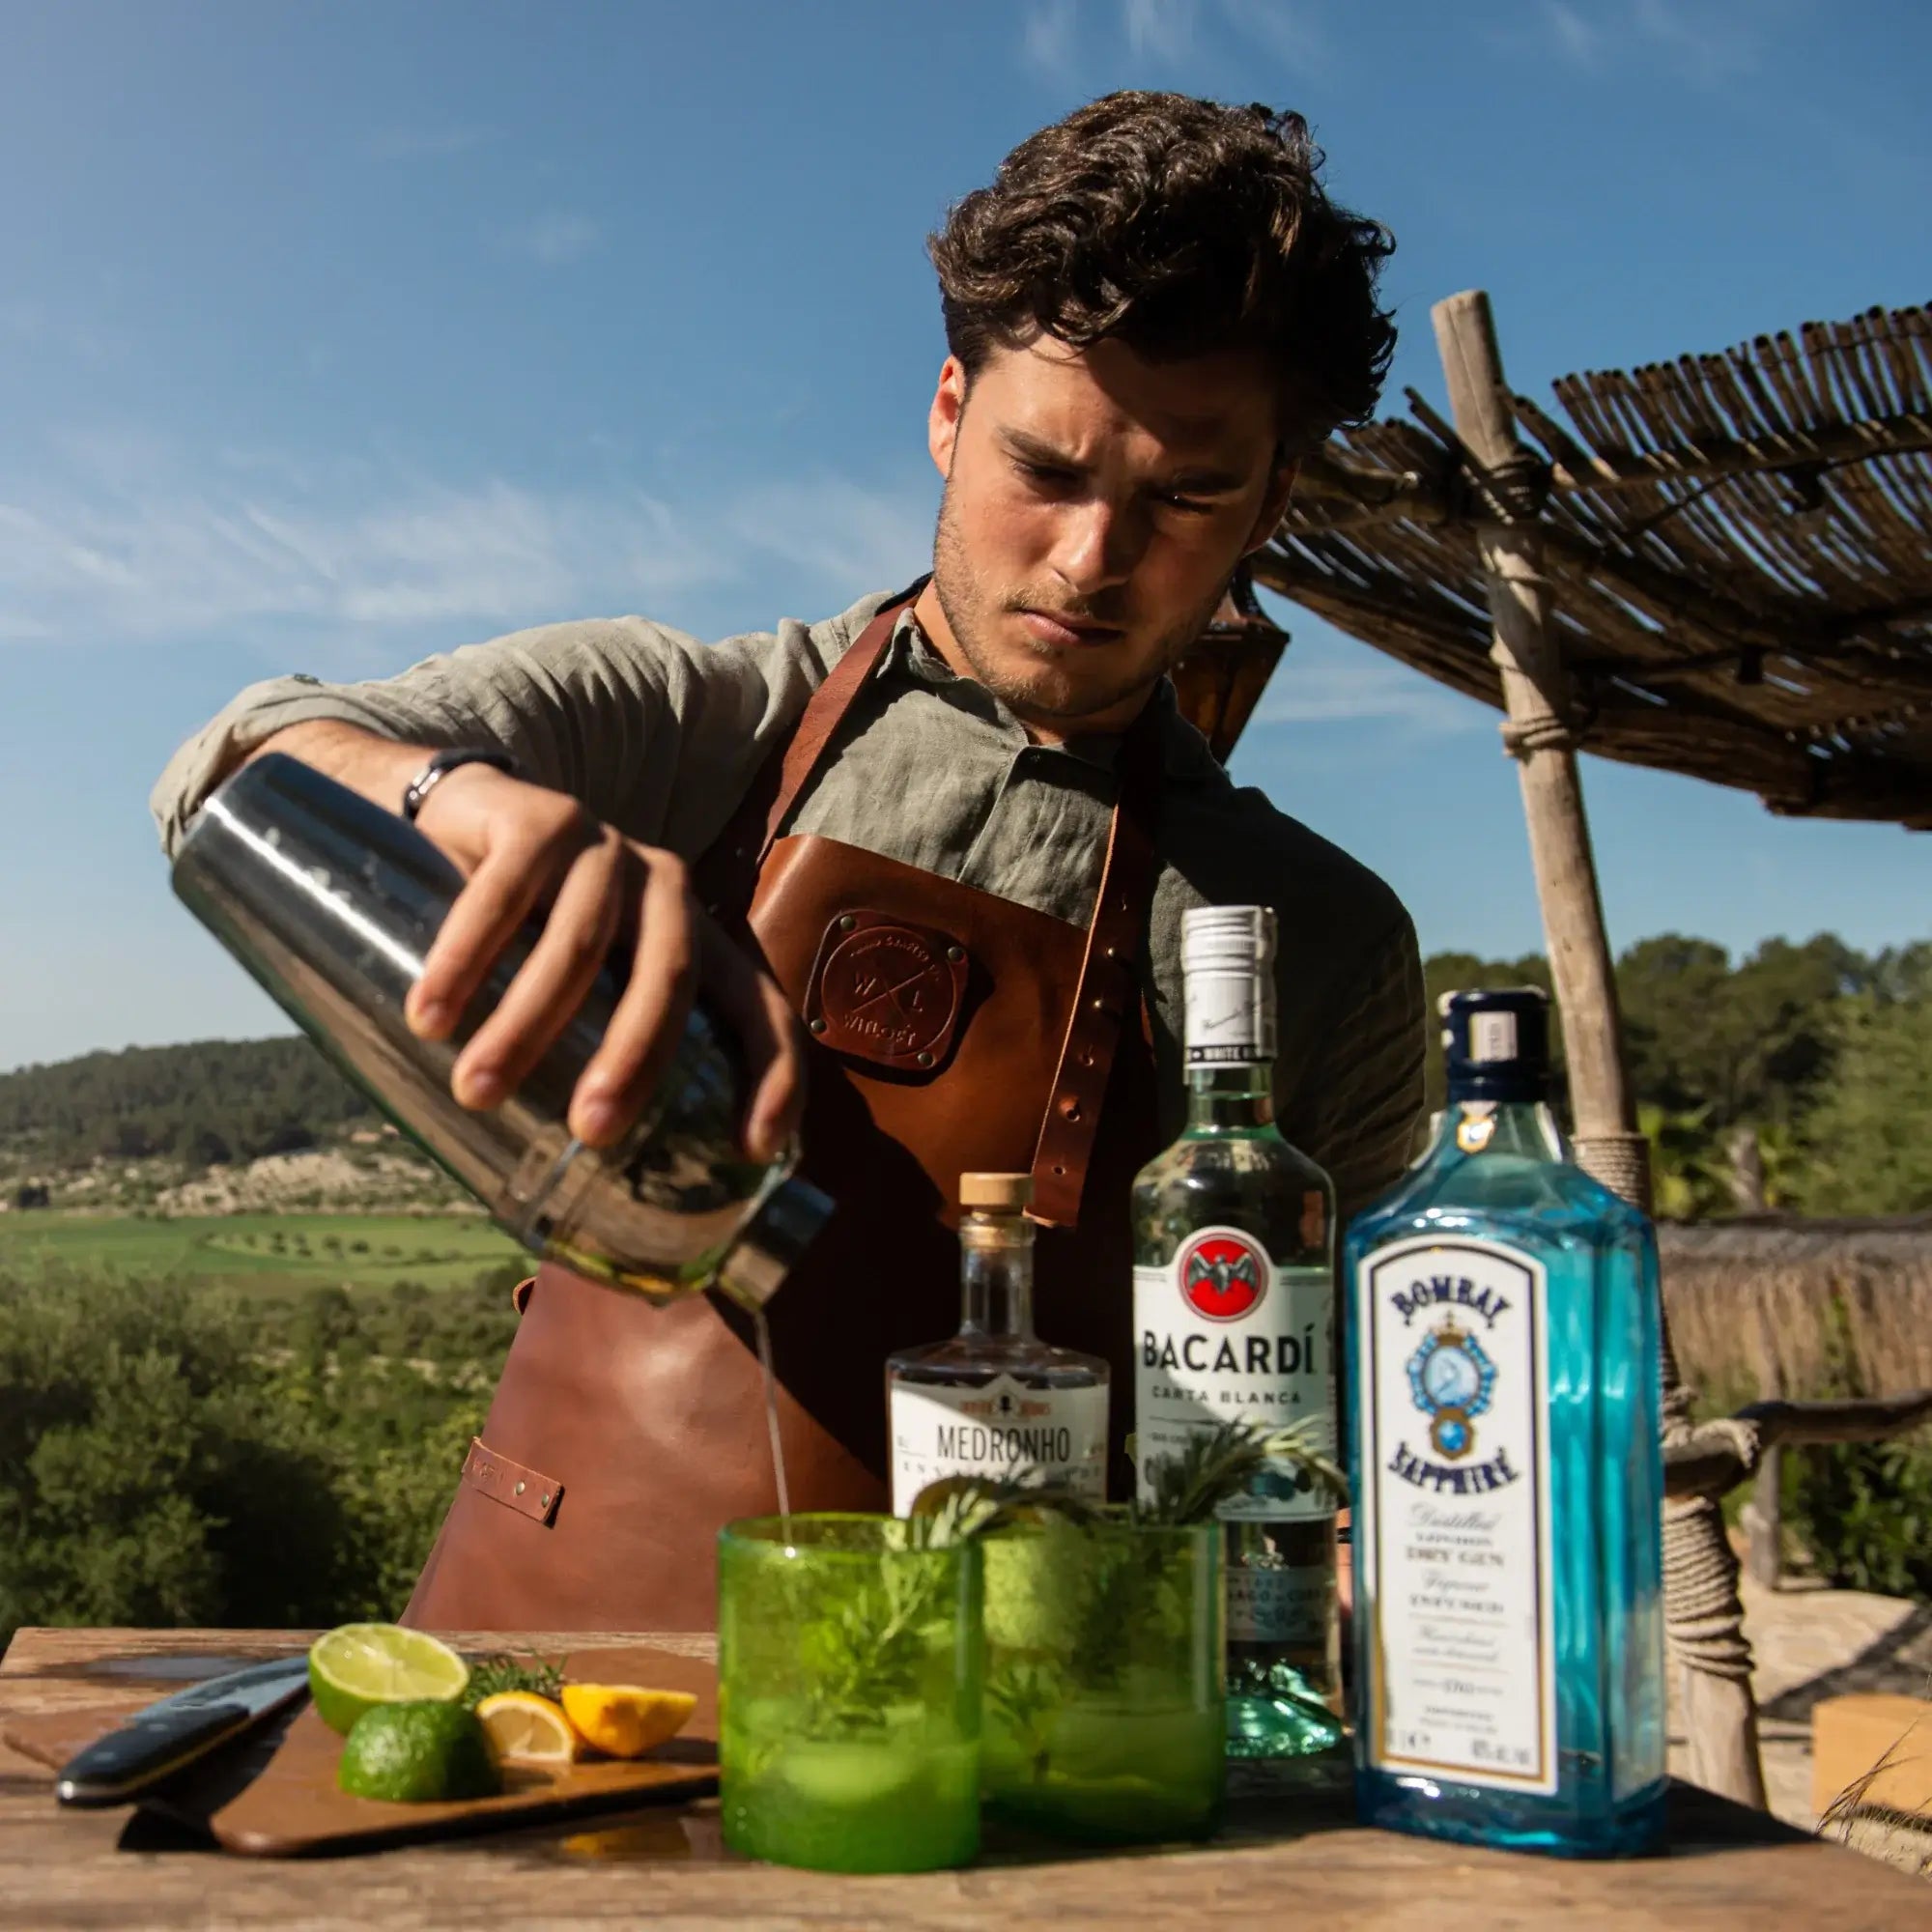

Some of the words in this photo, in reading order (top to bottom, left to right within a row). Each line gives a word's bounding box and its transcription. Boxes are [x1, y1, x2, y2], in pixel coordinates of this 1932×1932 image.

[1390, 1275, 1513, 1330] BOMBAY
[1143, 1322, 1316, 1375] BACARDÍ
[1151, 1384, 1210, 1402] CARTA
[1220, 1390, 1302, 1404] BLANCA
[936, 1424, 1070, 1463] MEDRONHO
[1387, 1440, 1520, 1494] SAPPHIRE
